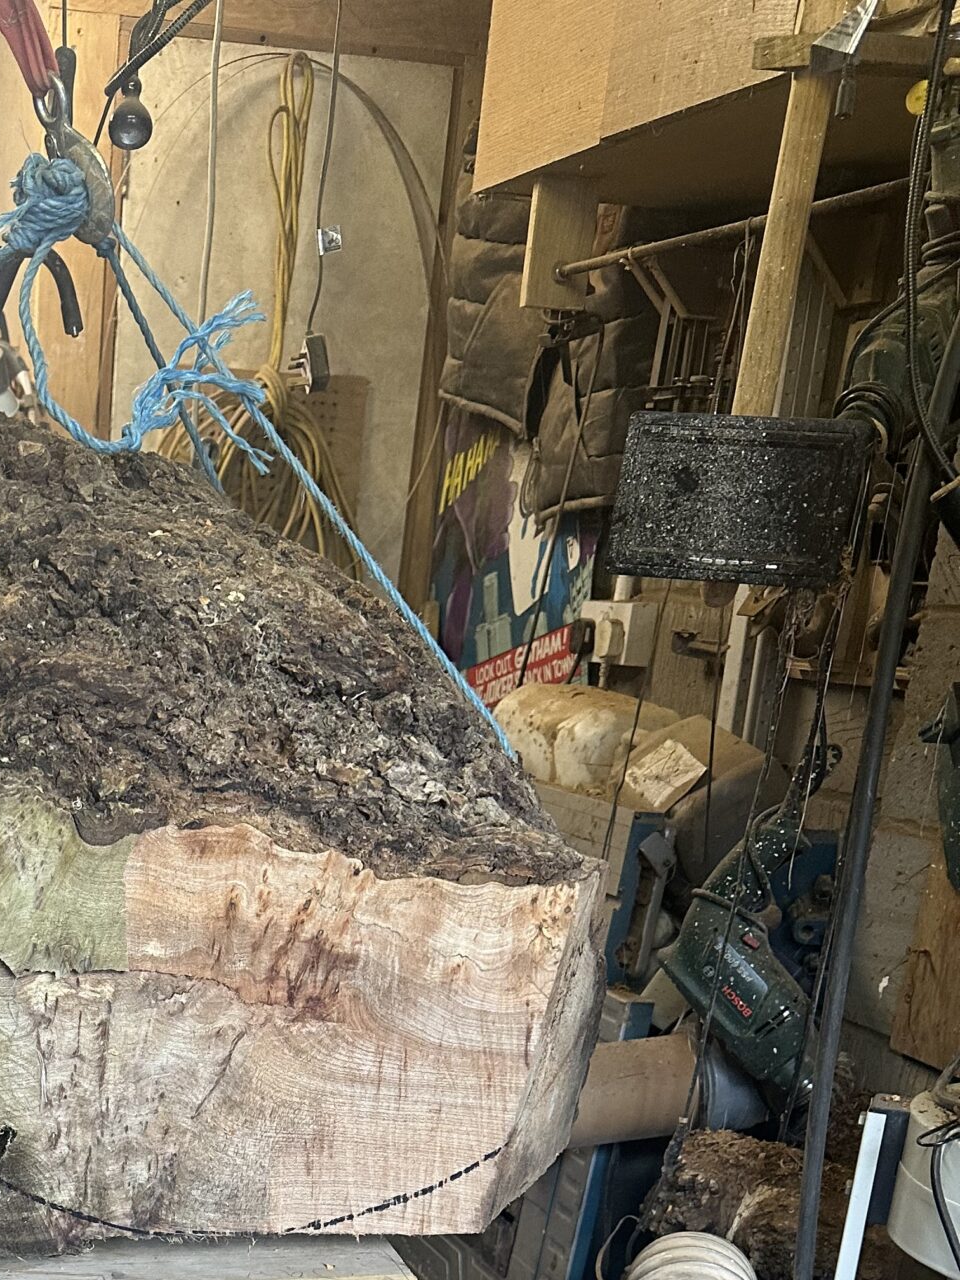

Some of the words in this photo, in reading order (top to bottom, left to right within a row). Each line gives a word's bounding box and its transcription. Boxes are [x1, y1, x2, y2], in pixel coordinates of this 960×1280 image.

[475, 661, 496, 686] LOOK
[495, 654, 512, 677] OUT
[721, 985, 753, 1018] BOSCH
